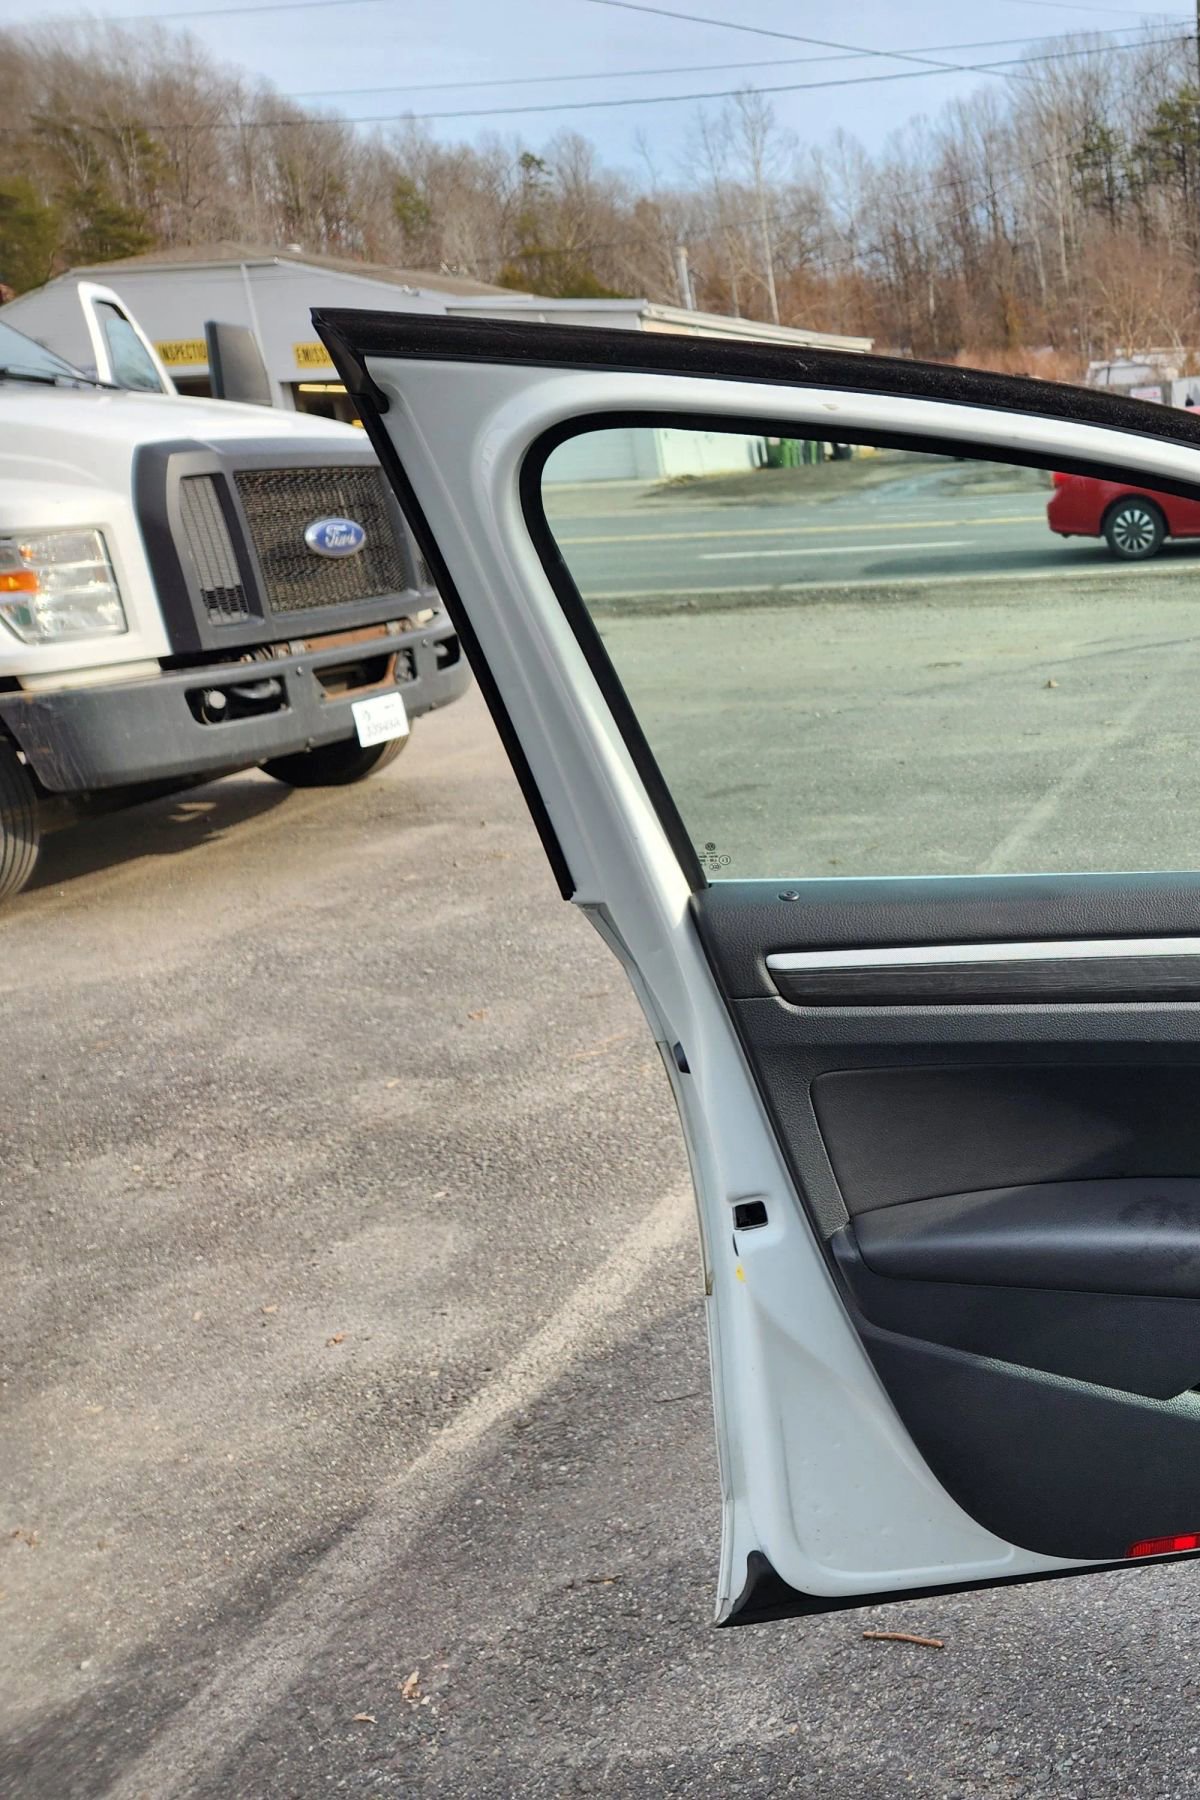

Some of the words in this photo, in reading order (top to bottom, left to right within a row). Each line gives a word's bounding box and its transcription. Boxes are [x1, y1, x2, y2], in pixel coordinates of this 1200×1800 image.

[158, 342, 208, 362] INSPECTIO
[295, 345, 330, 363] EMISS
[325, 524, 357, 548] Ford
